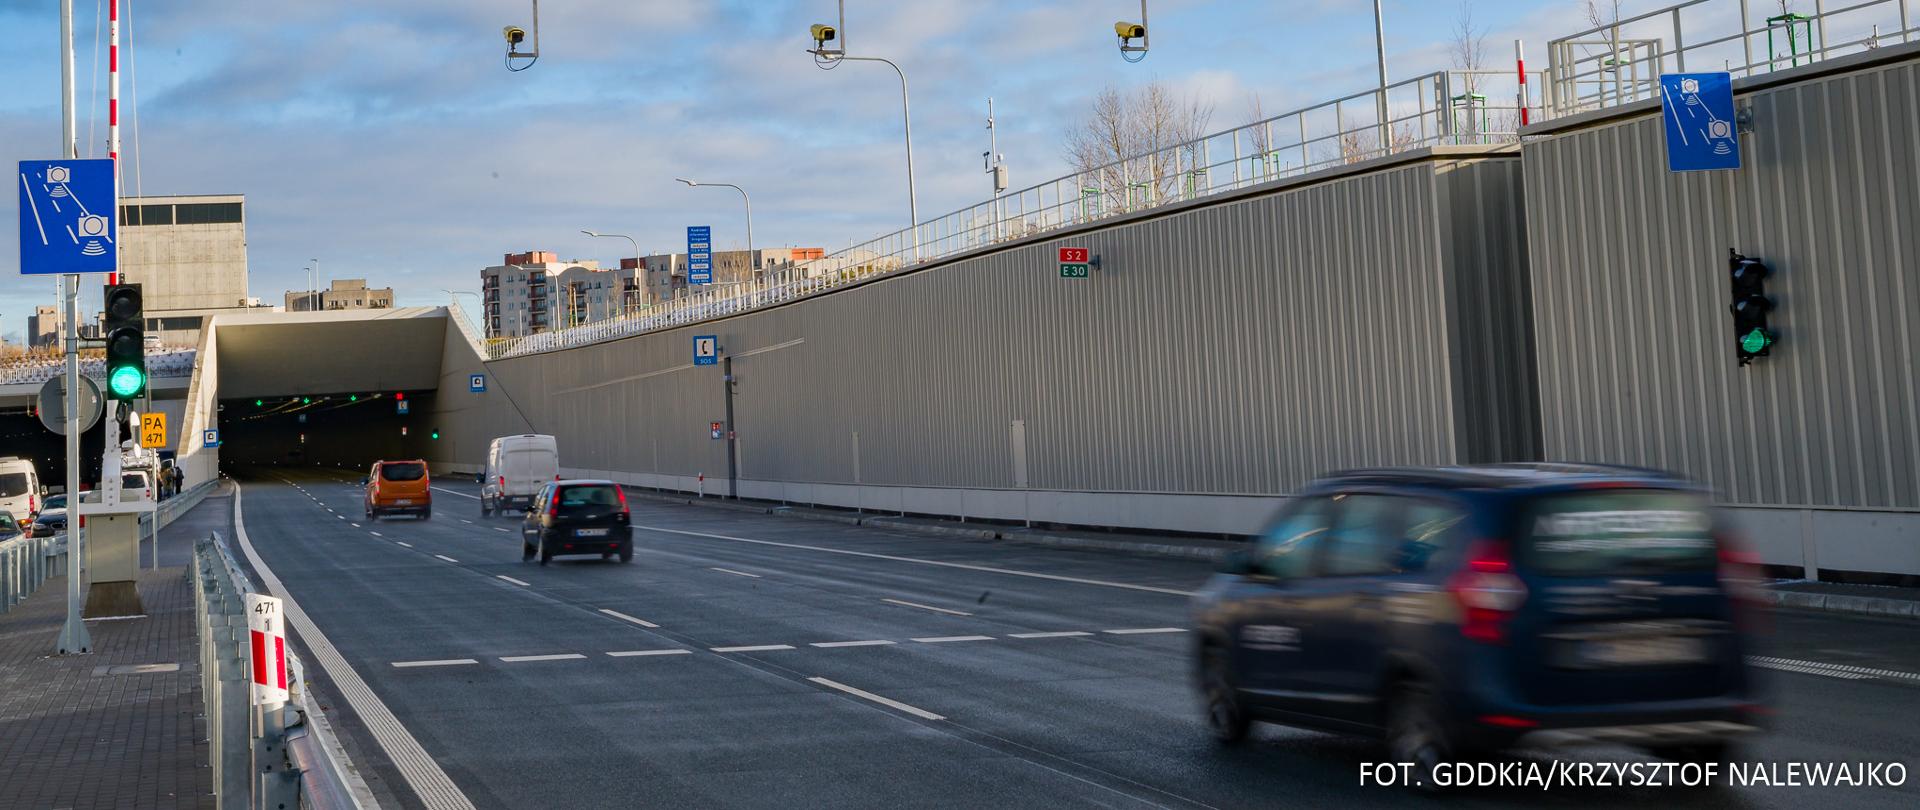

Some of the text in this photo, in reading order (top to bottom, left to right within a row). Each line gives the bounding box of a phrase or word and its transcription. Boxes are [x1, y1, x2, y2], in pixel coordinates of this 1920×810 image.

[1066, 250, 1081, 260] S 2
[1063, 266, 1085, 276] E 30
[145, 417, 163, 430] PA
[146, 433, 163, 444] 471
[255, 602, 275, 615] 471
[265, 620, 270, 631] 1
